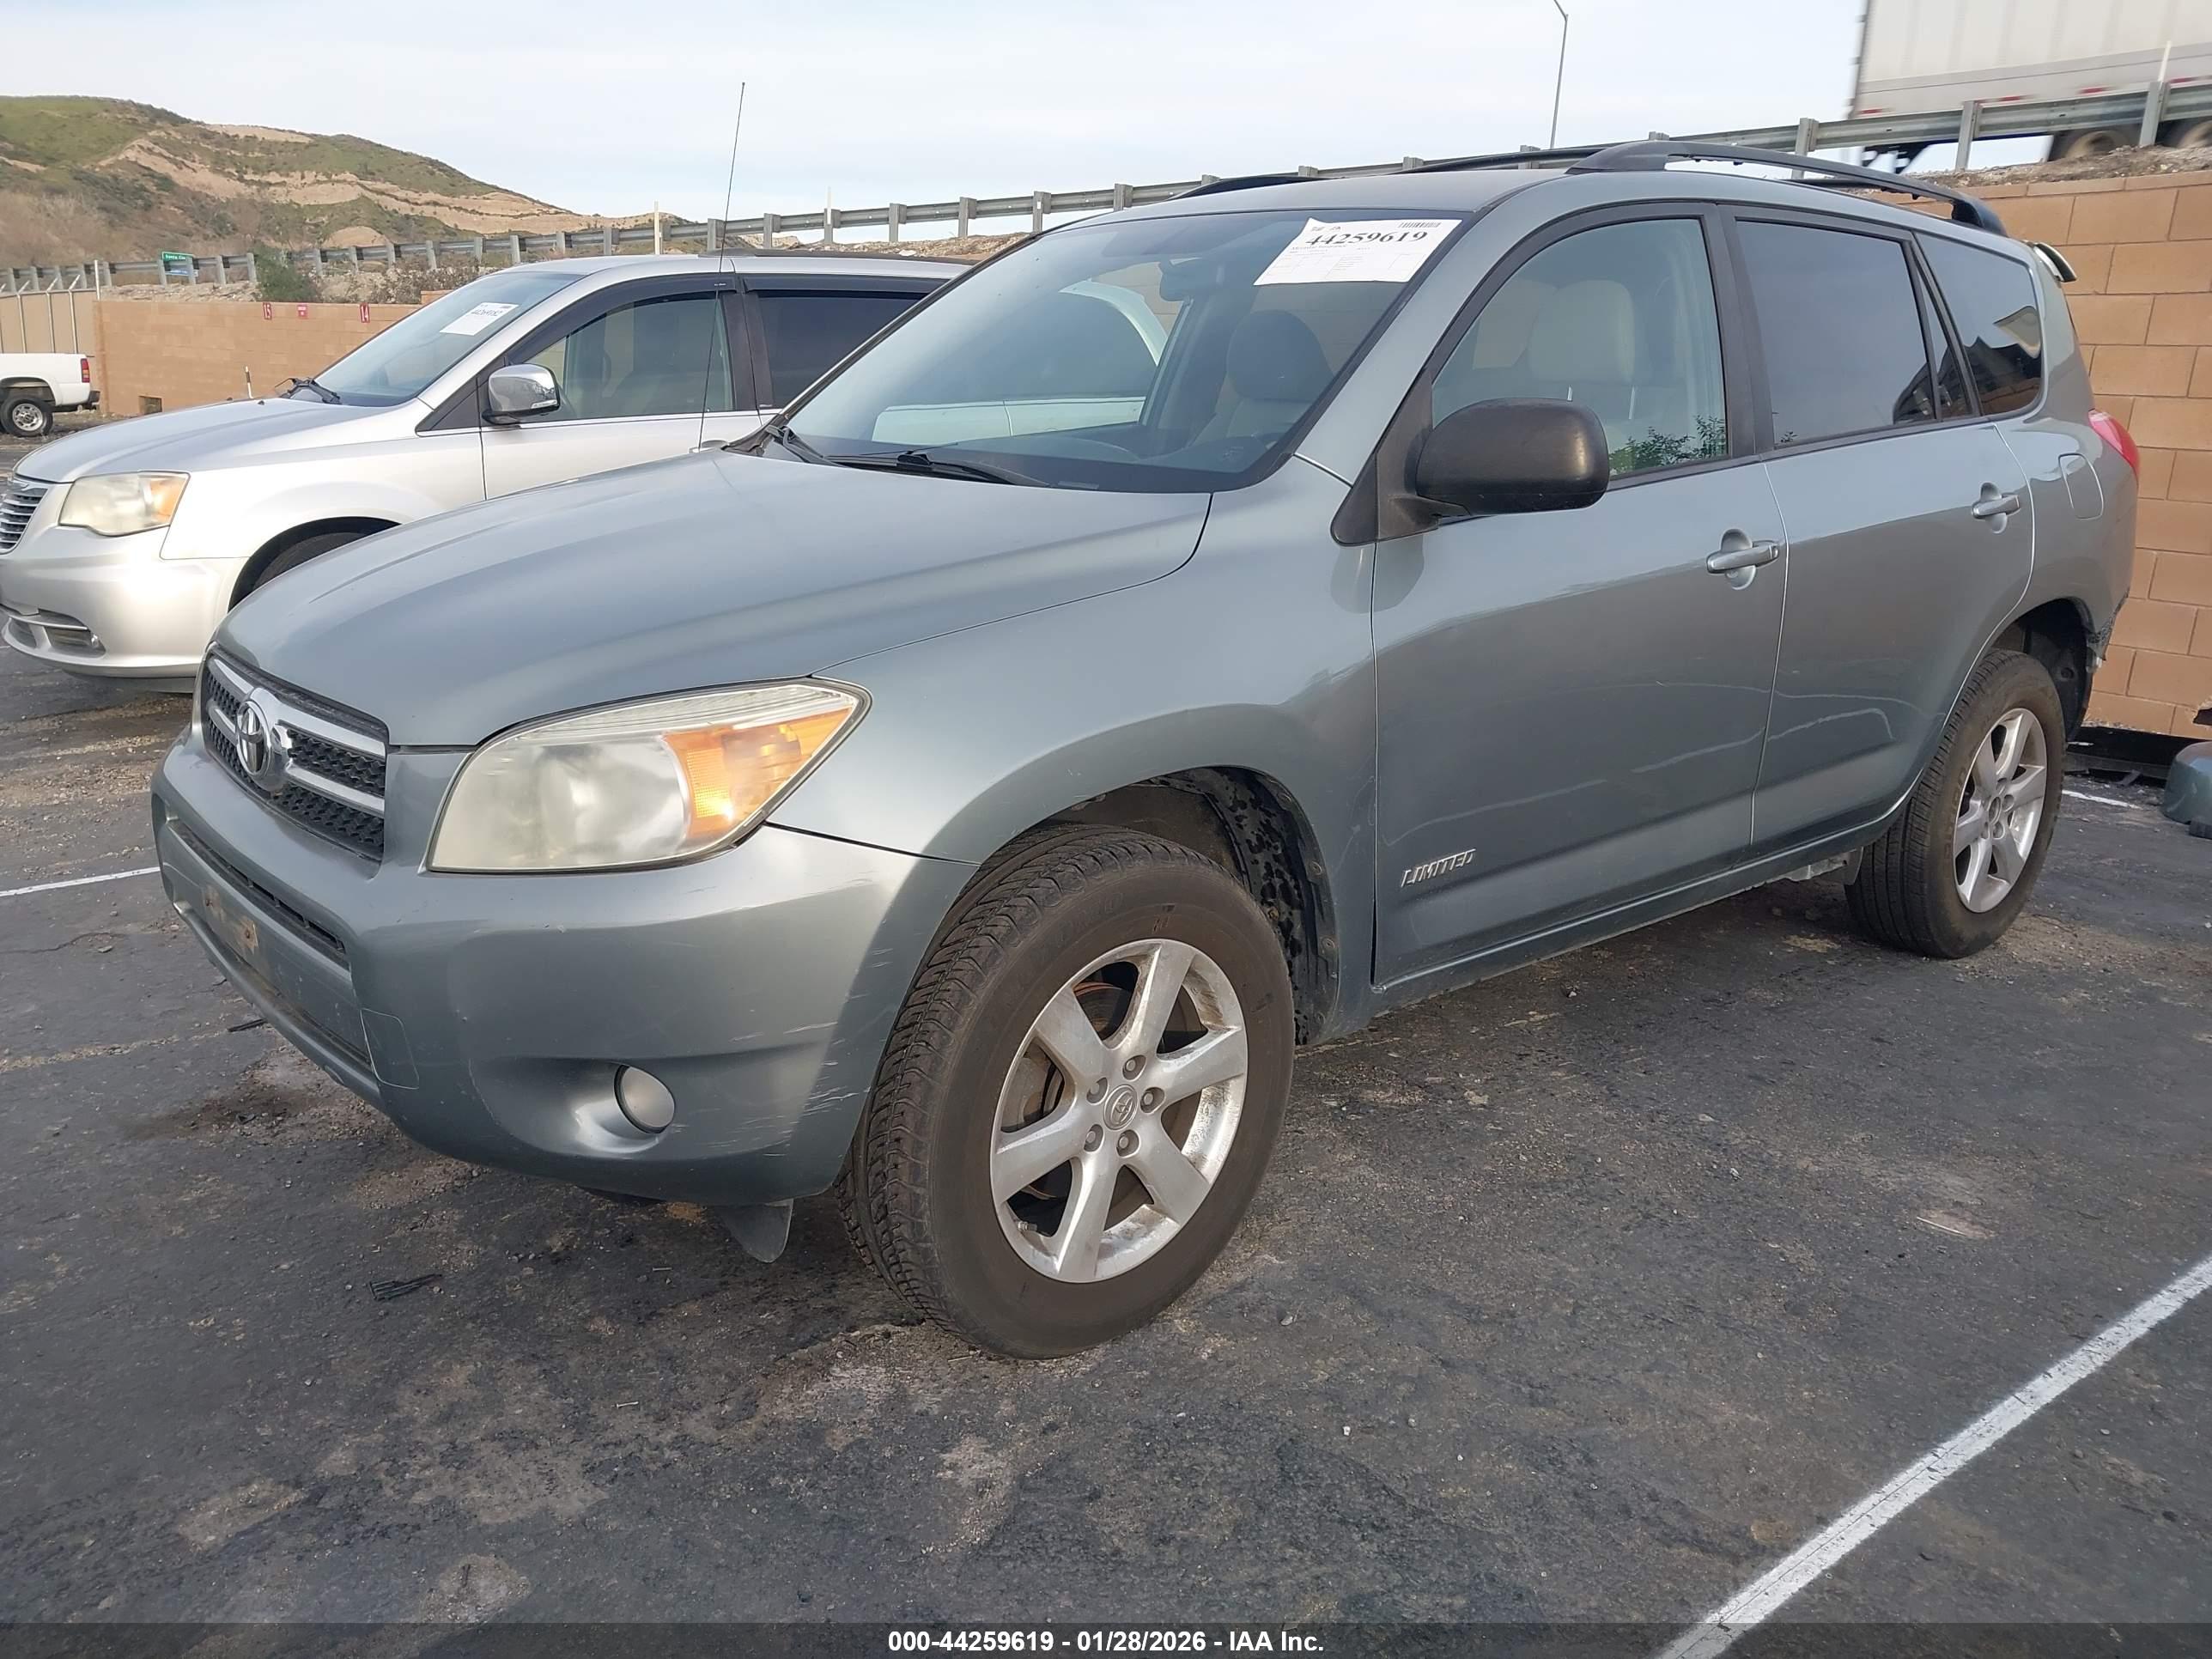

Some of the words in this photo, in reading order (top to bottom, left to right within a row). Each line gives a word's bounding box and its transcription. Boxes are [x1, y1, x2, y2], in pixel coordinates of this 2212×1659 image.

[1305, 231, 1428, 246] 44259619
[264, 303, 272, 319] 15
[361, 305, 369, 322] 14
[1401, 848, 1476, 887] LIMITED
